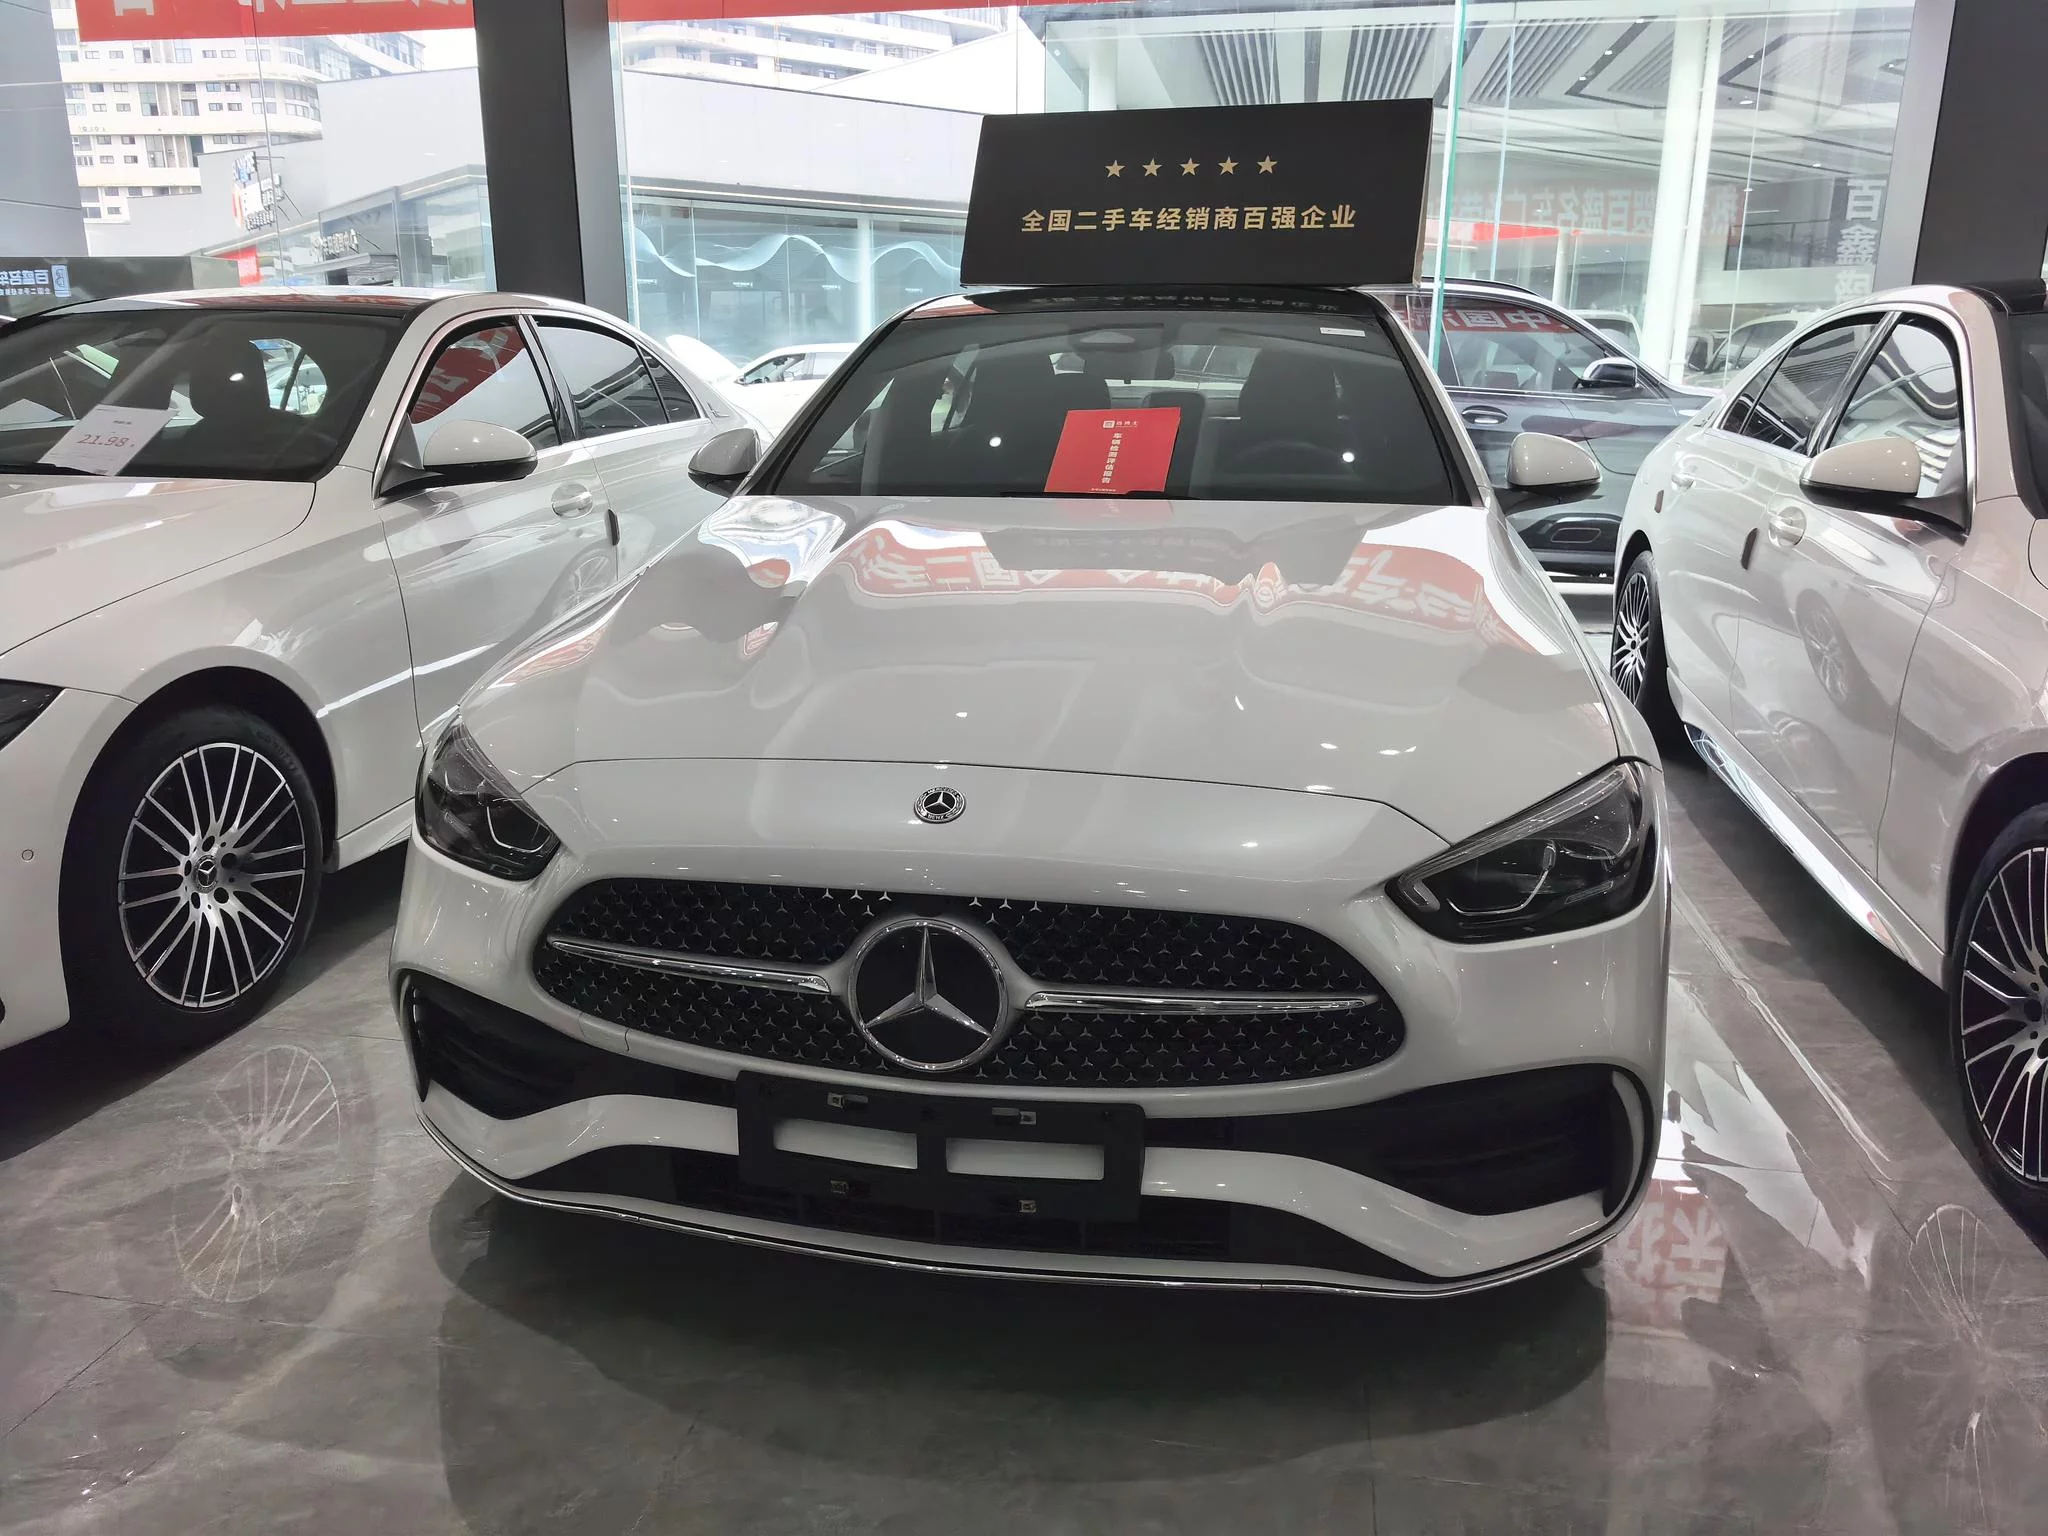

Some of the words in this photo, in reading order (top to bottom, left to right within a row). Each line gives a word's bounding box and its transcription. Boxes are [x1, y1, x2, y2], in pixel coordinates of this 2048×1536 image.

[1021, 204, 1357, 233] 全国二手车经销商百强企业
[77, 434, 129, 448] 21.98
